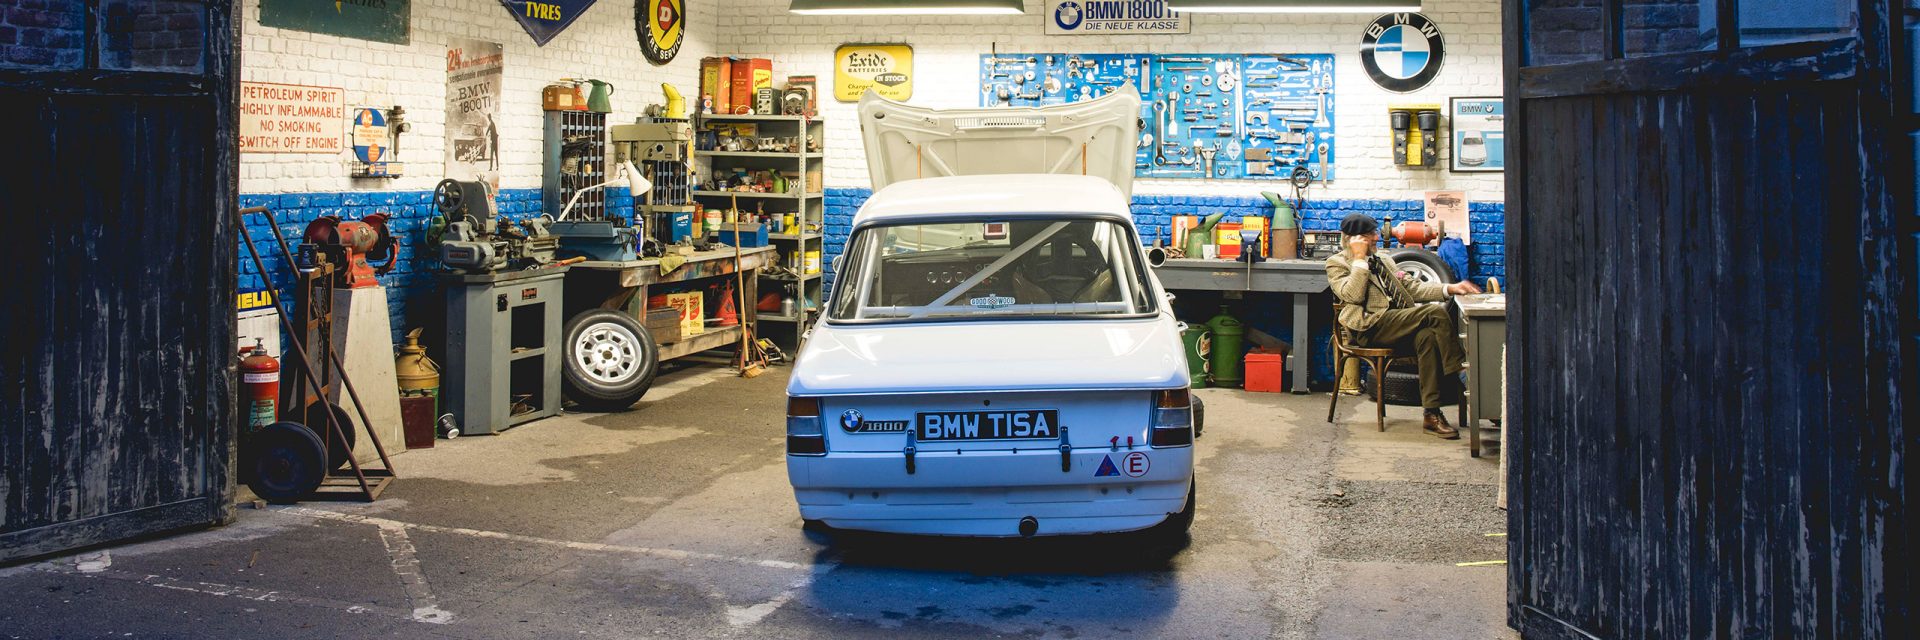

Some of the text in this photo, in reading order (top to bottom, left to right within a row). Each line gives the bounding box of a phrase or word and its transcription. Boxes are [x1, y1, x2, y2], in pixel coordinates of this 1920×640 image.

[526, 1, 561, 21] TYRES
[1085, 1, 1124, 19] BMW
[1126, 0, 1163, 19] 1800
[1085, 21, 1179, 30] DIE NEUE KLASSE
[1367, 12, 1438, 39] BMW
[645, 21, 684, 60] TYRE SERVICE
[848, 52, 887, 67] Exide
[243, 86, 336, 103] PETROLEUM SPIRIT
[458, 81, 490, 100] BMW
[239, 103, 341, 118] HIGHLY INFLAMMABLE
[260, 120, 322, 133] NO SMOKING
[239, 136, 338, 149] SWITCH OFF ENGINE
[864, 422, 904, 431] 1800
[924, 412, 1050, 438] BMW TISA
